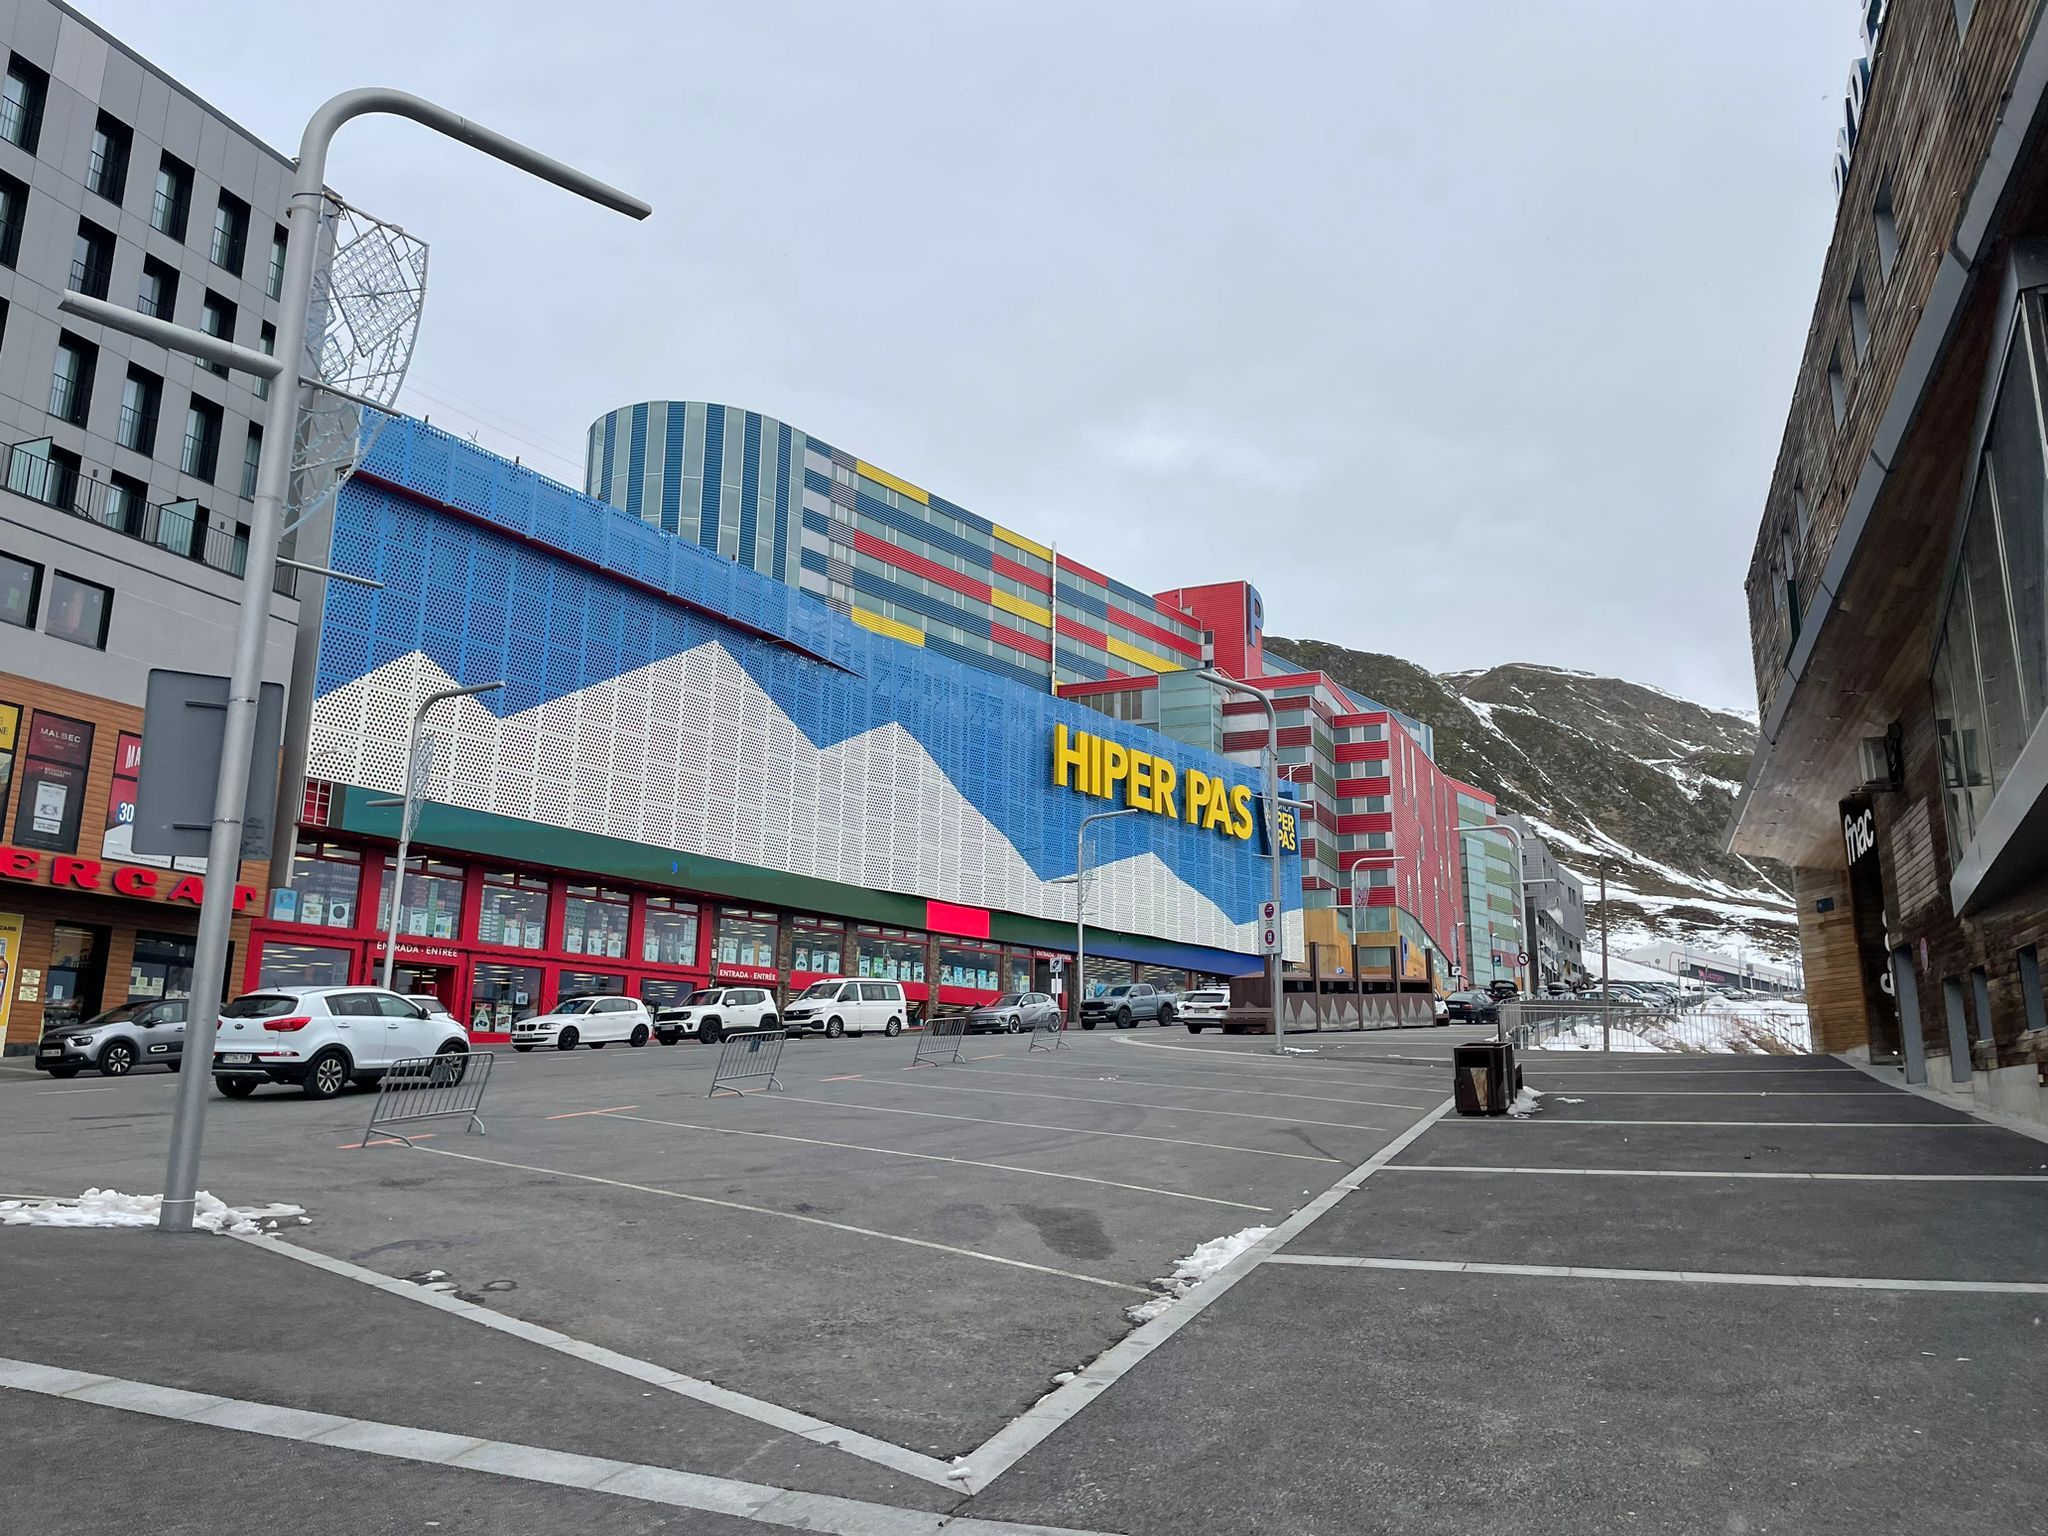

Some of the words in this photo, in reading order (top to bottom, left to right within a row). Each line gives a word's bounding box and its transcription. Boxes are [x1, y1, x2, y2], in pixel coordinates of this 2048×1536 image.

[1248, 583, 1265, 648] P
[40, 726, 82, 744] MALBEC
[1054, 723, 1178, 819] HIPER
[1185, 768, 1254, 841] PAS
[119, 802, 135, 823] 30
[1844, 808, 1875, 867] fnac
[376, 941, 419, 954] ENRADA
[719, 969, 749, 979] ENTRADA
[754, 972, 776, 981] ENTRÉE
